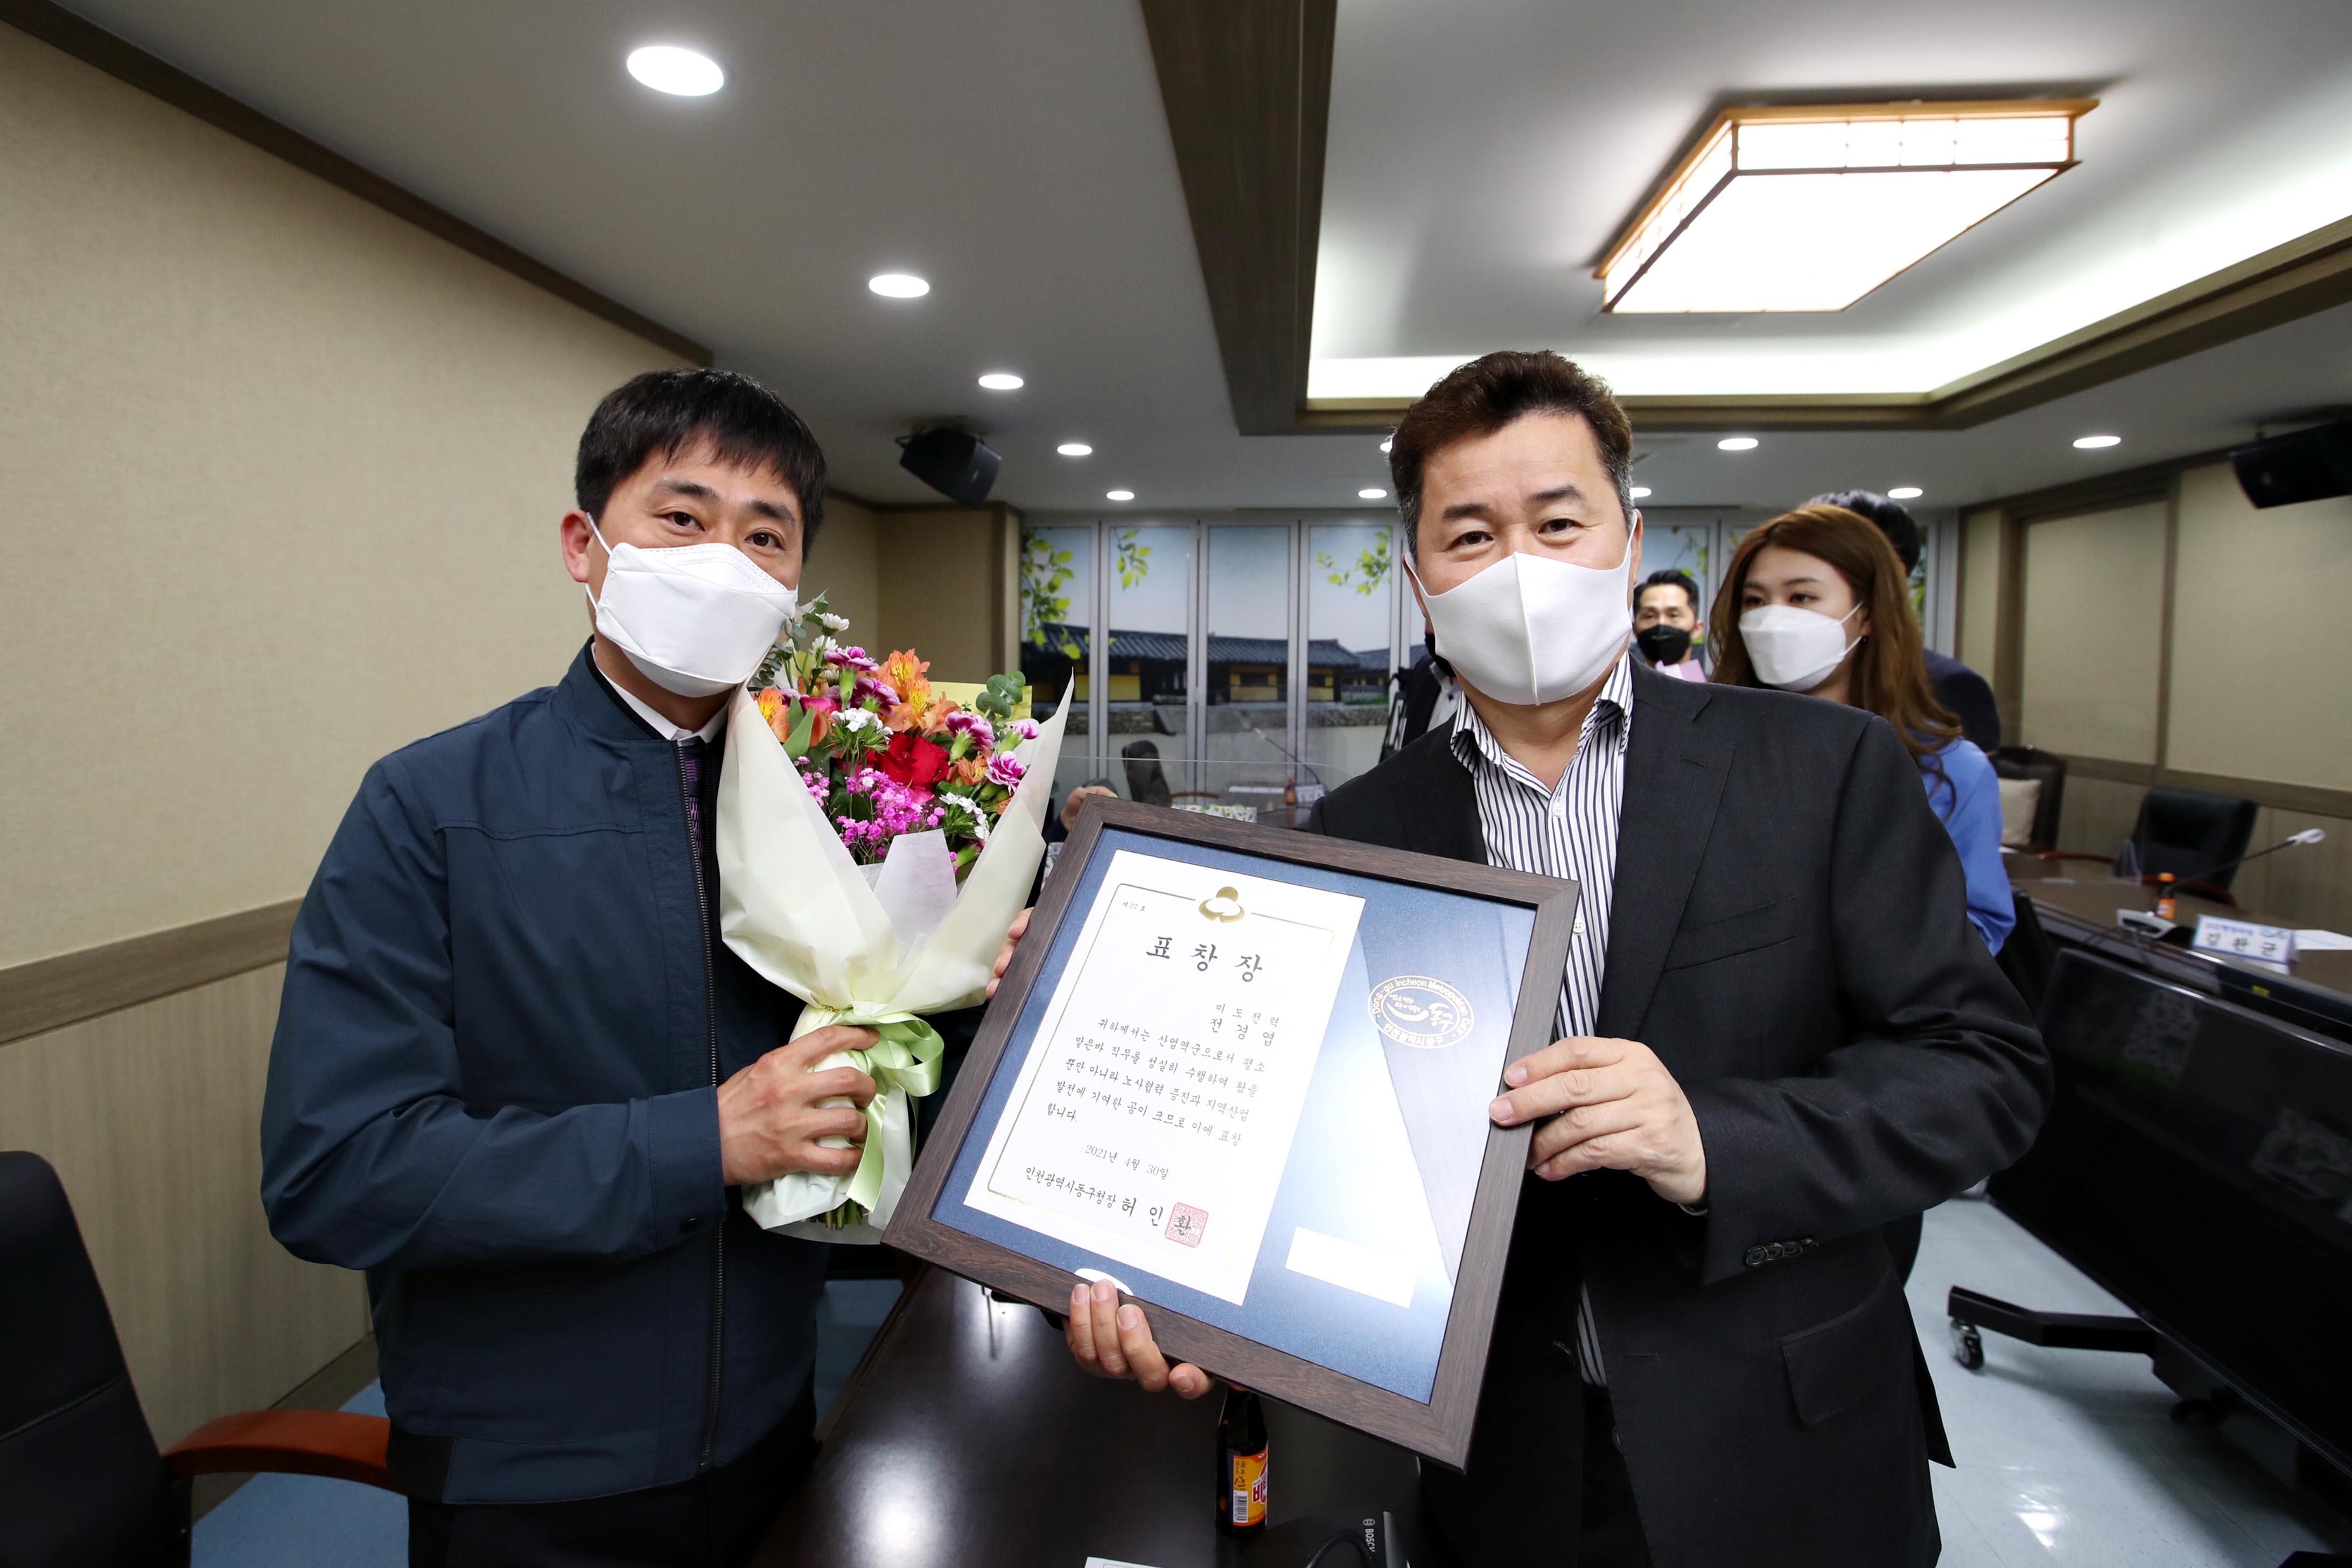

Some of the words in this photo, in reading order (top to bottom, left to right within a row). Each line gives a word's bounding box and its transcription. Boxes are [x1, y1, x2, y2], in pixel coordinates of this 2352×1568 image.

[1373, 983, 1394, 1014] Dong-gu
[1395, 978, 1427, 988] Incheon
[1098, 1019, 1150, 1041] 귀하께서는
[1158, 1035, 1235, 1064] 산업역군으로서
[1243, 1057, 1265, 1073] 평소
[1066, 1058, 1084, 1073] 뿐만
[1089, 1065, 1119, 1082] 아니라
[1122, 1075, 1164, 1096] 노사협력
[1170, 1088, 1201, 1107] 증진과
[1206, 1099, 1249, 1122] 지역산업
[1111, 1046, 1140, 1064] 직무를
[1147, 1057, 1179, 1074] 성실히
[1186, 1067, 1228, 1087] 수행하여
[1236, 1081, 1258, 1097] 왔을
[1047, 1103, 1077, 1123] 합니다.
[1057, 1080, 1086, 1098] 발전에
[1090, 1091, 1122, 1110] 기여한
[1127, 1101, 1148, 1117] 공이
[1152, 1111, 1185, 1129] 크므로
[1192, 1121, 1213, 1137] 이에
[1218, 1130, 1242, 1146] 표창
[1084, 1145, 1118, 1163] 2021년
[1124, 1158, 1140, 1171] 4월
[1146, 1164, 1169, 1180] 30일
[1026, 1167, 1117, 1208] 인천광역시동구청장
